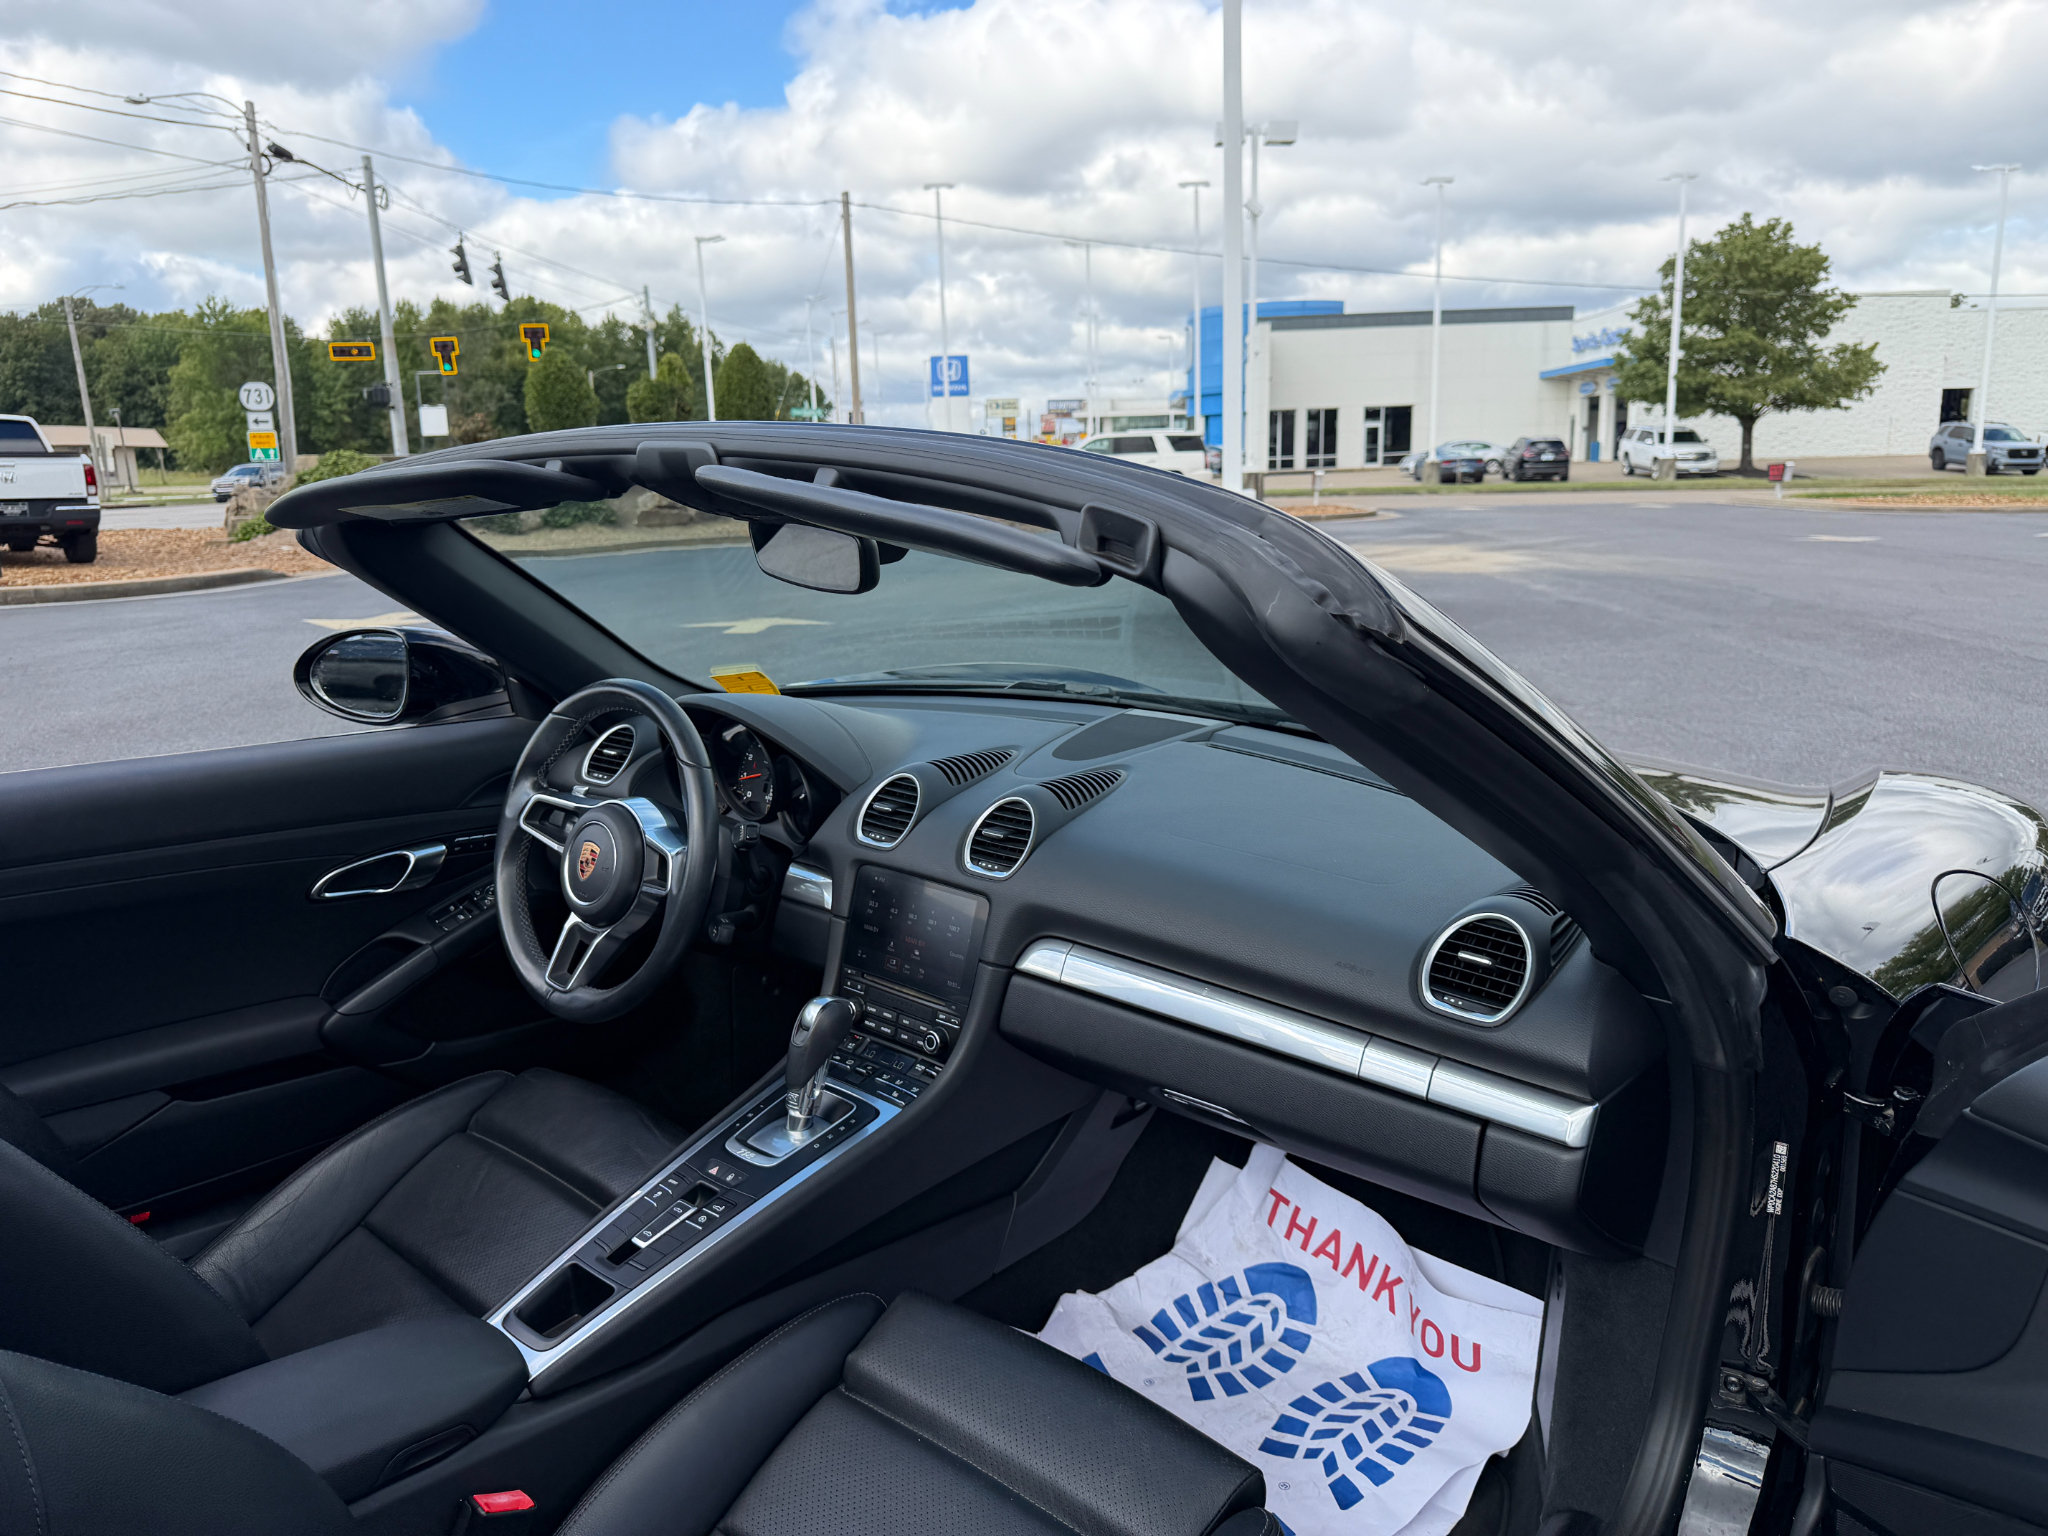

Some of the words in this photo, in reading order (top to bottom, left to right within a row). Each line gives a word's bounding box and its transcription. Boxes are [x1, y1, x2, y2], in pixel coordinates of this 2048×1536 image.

[244, 388, 270, 404] 731
[1267, 1187, 1404, 1316] THANK
[1408, 1291, 1481, 1373] YOU
